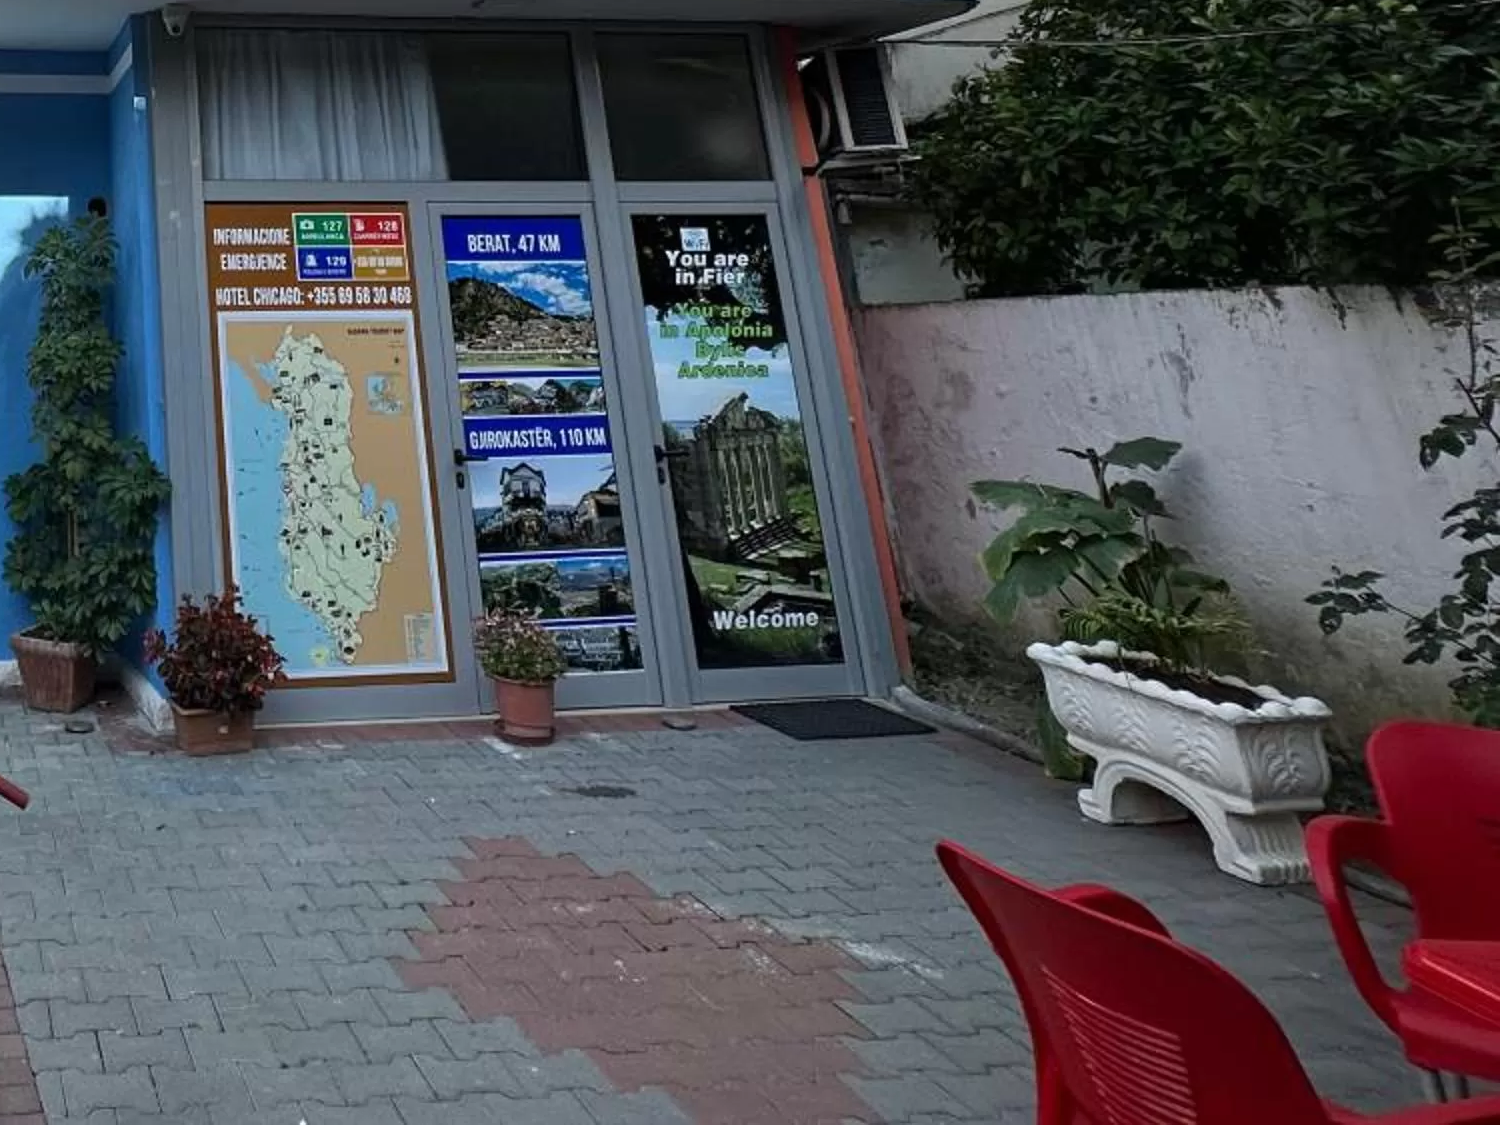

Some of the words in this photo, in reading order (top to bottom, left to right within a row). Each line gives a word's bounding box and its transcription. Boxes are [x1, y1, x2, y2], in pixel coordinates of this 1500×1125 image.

[323, 221, 343, 231] 127
[467, 234, 517, 254] BERAT,
[518, 234, 536, 252] 47
[538, 234, 561, 252] KM
[665, 250, 707, 267] You
[713, 252, 749, 267] are
[675, 268, 696, 285] in
[703, 268, 746, 286] Fier
[215, 287, 250, 305] HOTEL
[252, 286, 305, 306] CHICAGO:
[307, 286, 336, 305] +355
[372, 286, 388, 305] 30
[675, 302, 714, 319] You
[719, 304, 753, 318] are
[559, 428, 584, 448] 110
[585, 427, 607, 446] KM
[712, 610, 820, 631] Welcome
